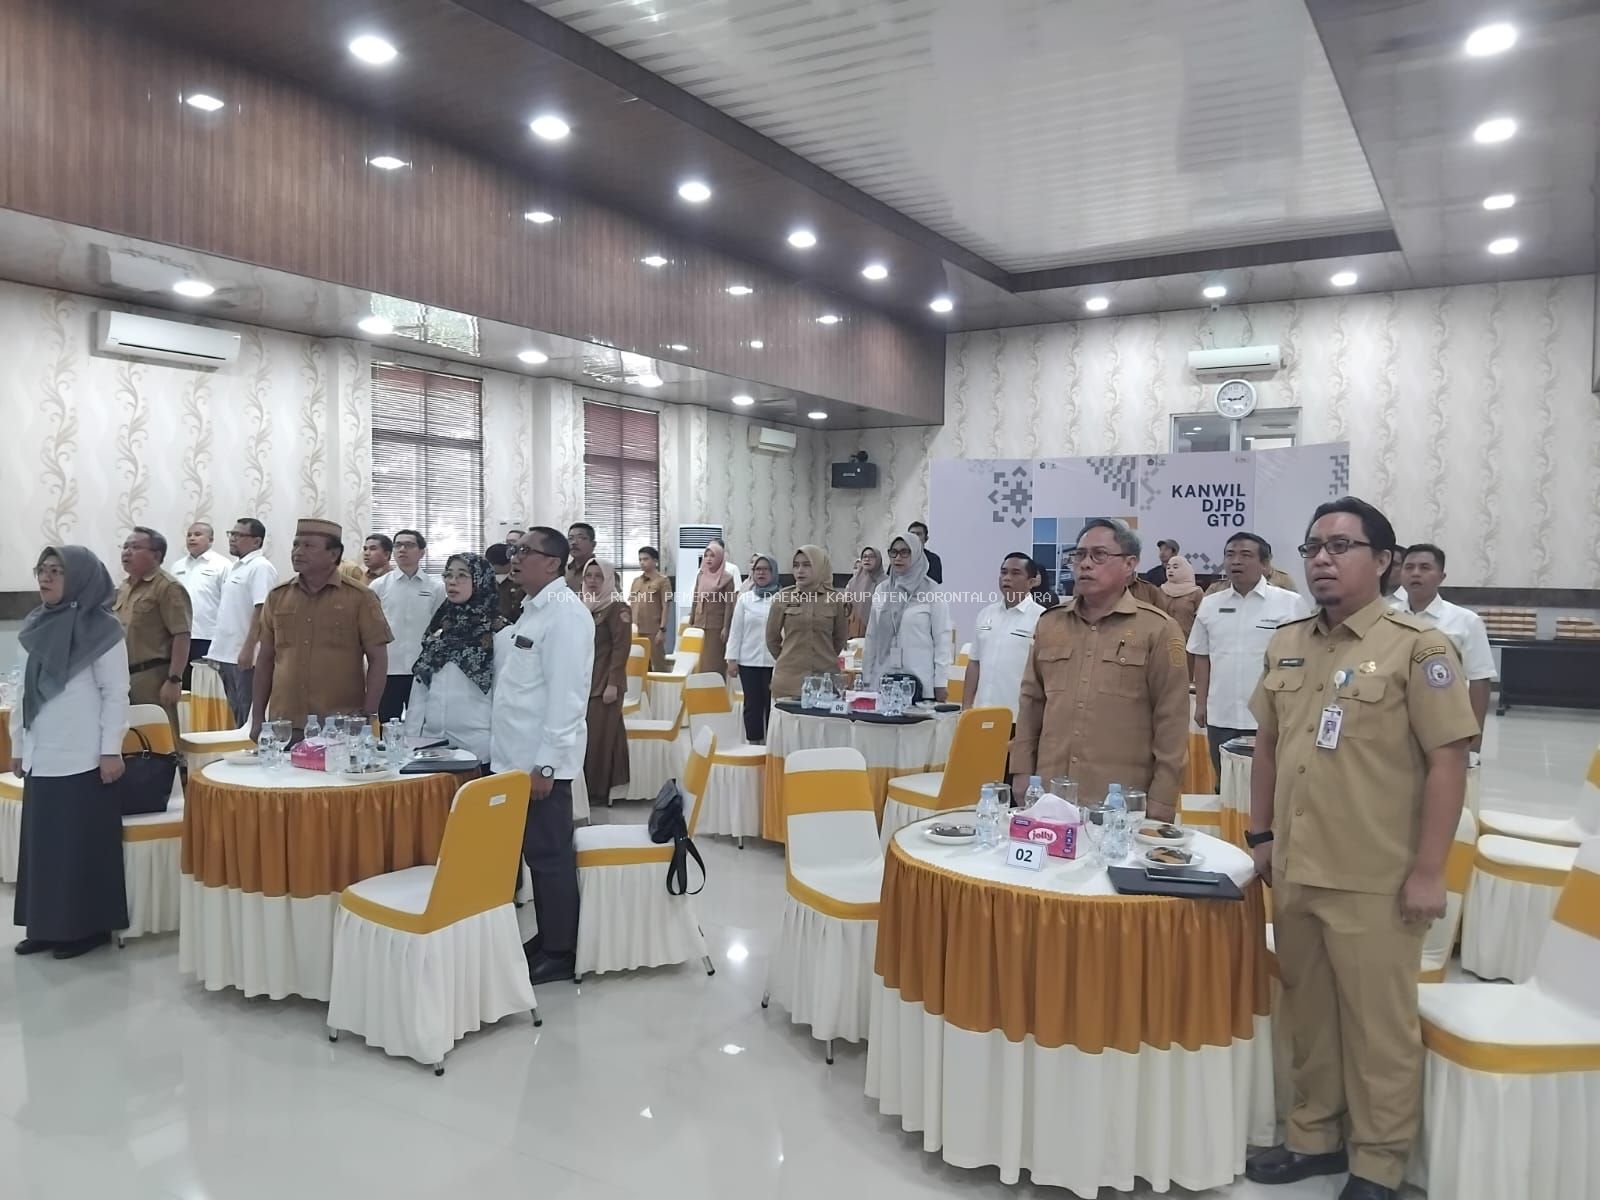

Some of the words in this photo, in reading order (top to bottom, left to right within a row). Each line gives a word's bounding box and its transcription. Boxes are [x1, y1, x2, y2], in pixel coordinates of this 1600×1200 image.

[1172, 484, 1246, 498] KANWIL
[1202, 499, 1246, 513] DJPb
[1207, 513, 1245, 527] GTO
[835, 704, 844, 712] 06
[1032, 830, 1054, 841] jolly
[1015, 848, 1033, 862] 02
